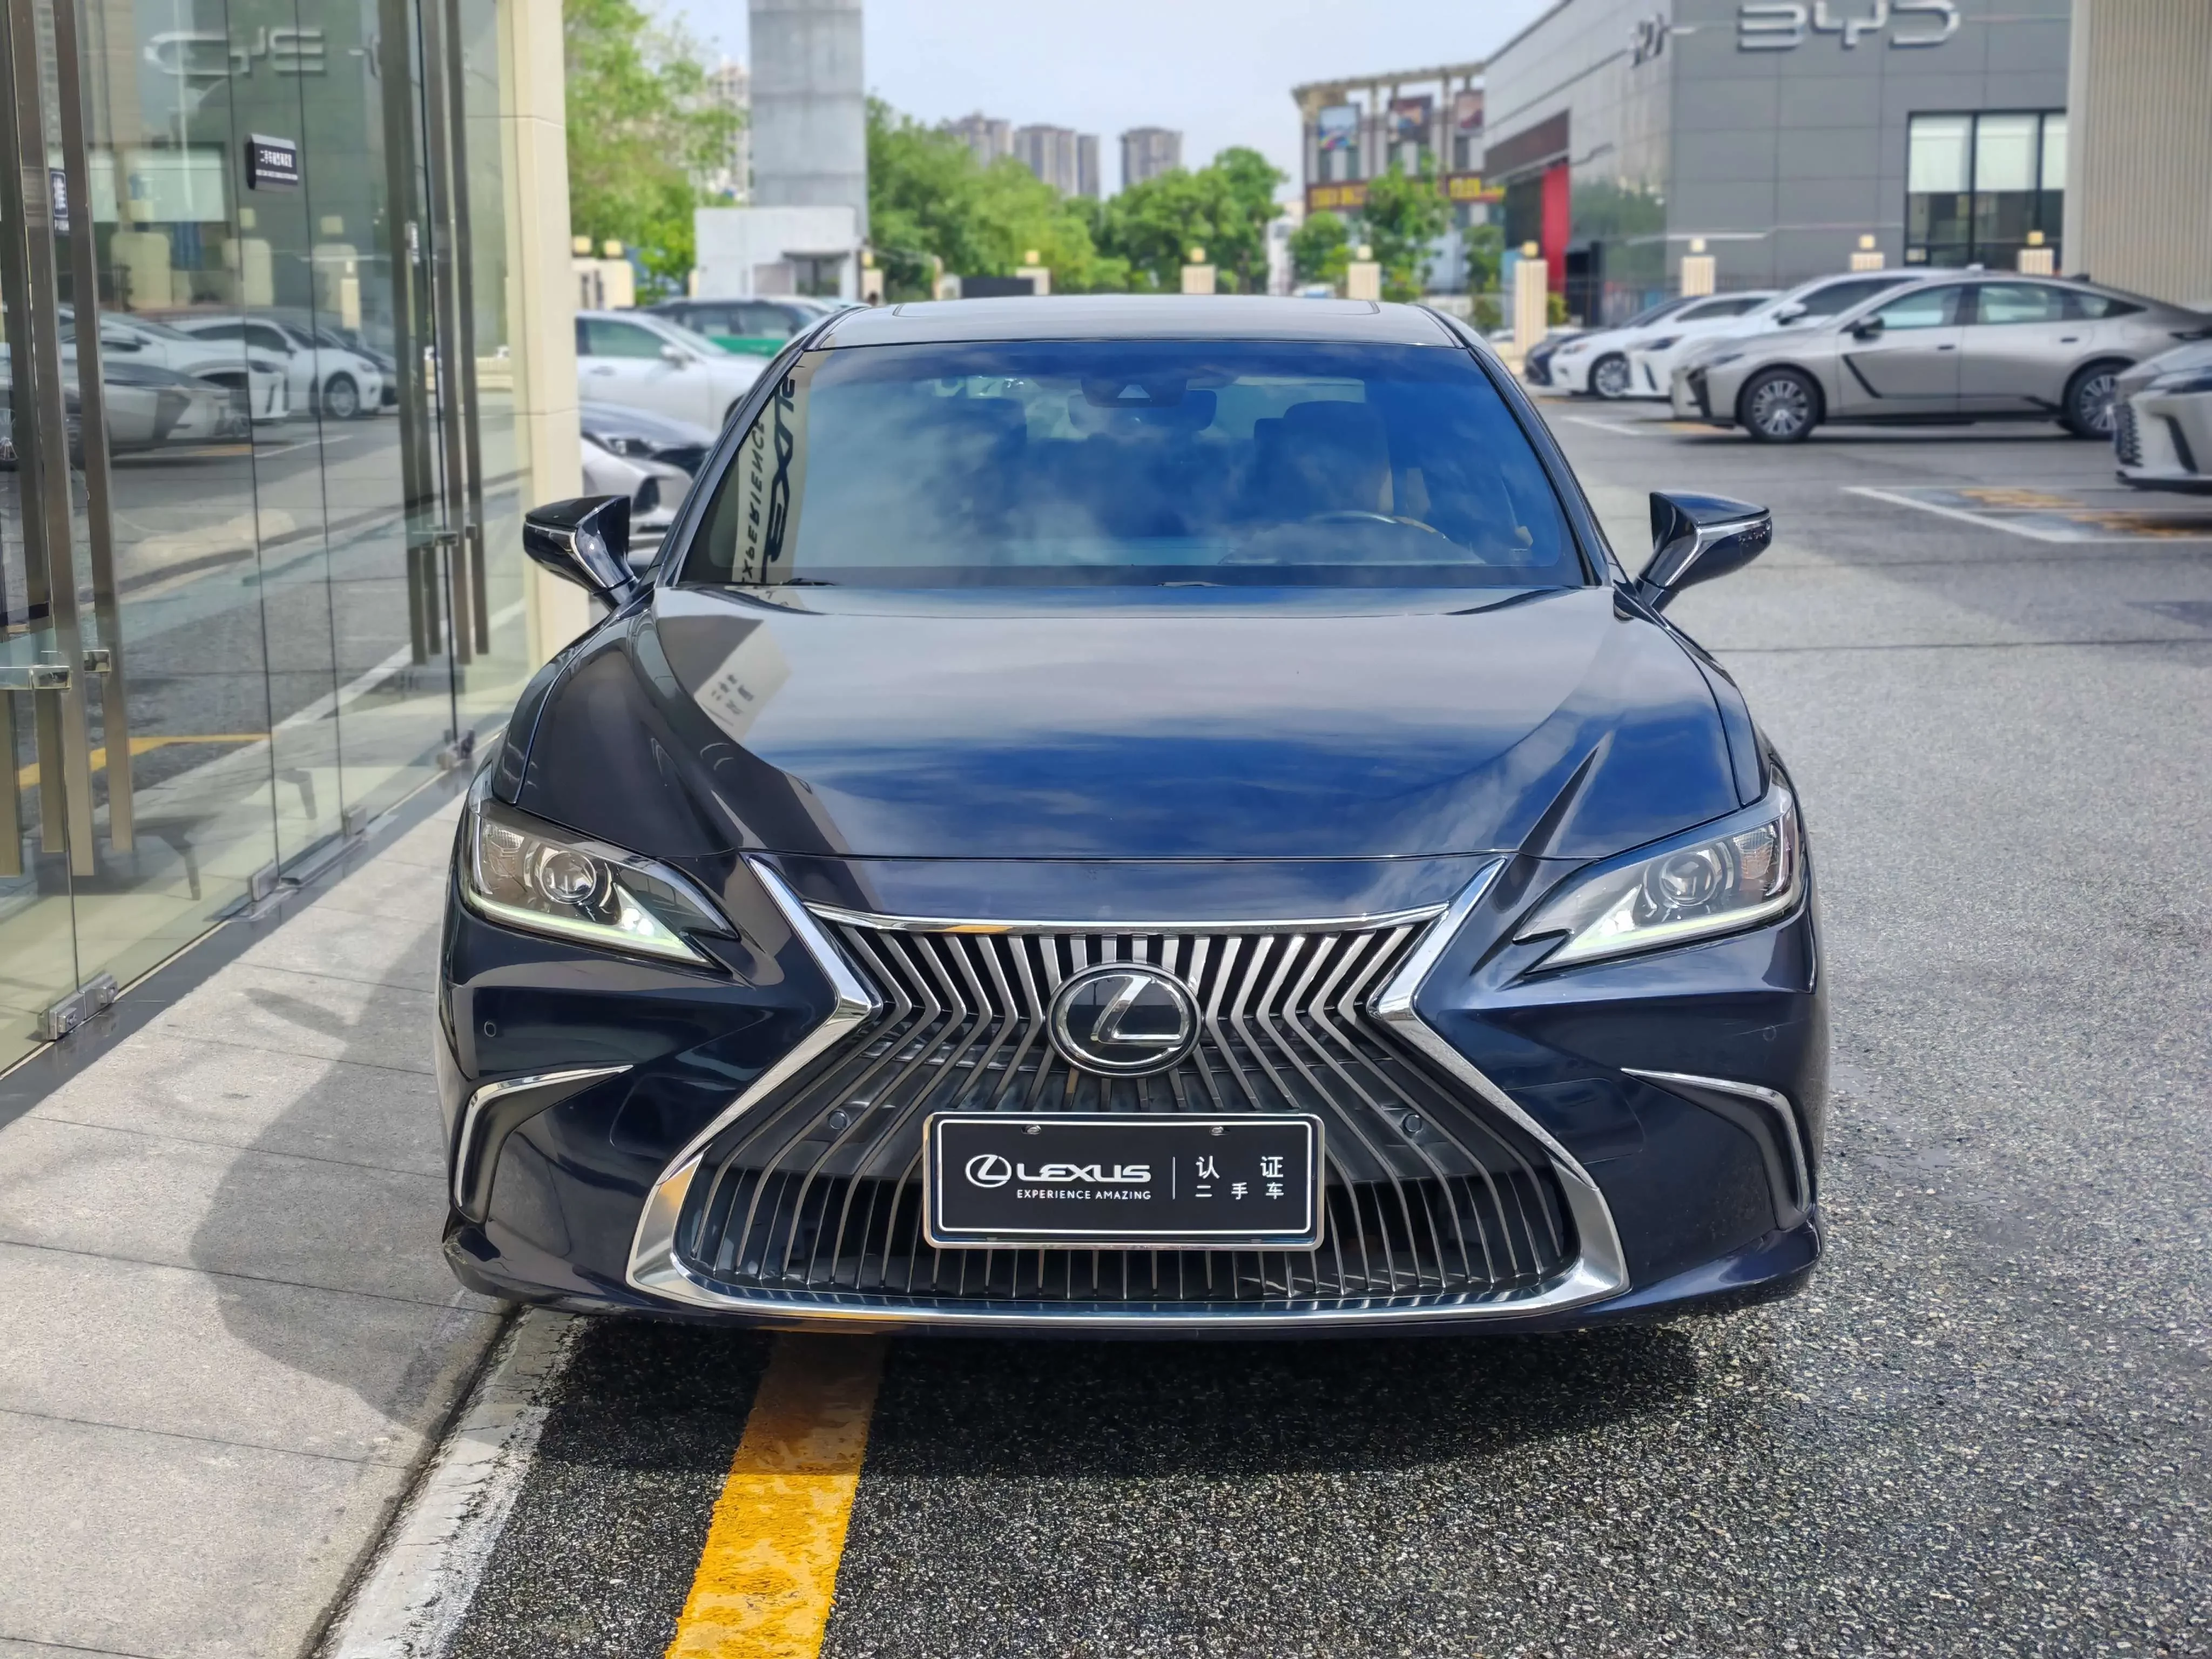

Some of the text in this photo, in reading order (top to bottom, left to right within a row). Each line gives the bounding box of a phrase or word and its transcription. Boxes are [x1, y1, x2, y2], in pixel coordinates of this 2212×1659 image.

[1738, 0, 1961, 50] BYD
[1017, 1163, 1151, 1183] LEXUS
[1195, 1155, 1284, 1179] 认证
[1017, 1189, 1151, 1200] EXPERIENCE AMAZING
[1195, 1182, 1284, 1200] 二手车
